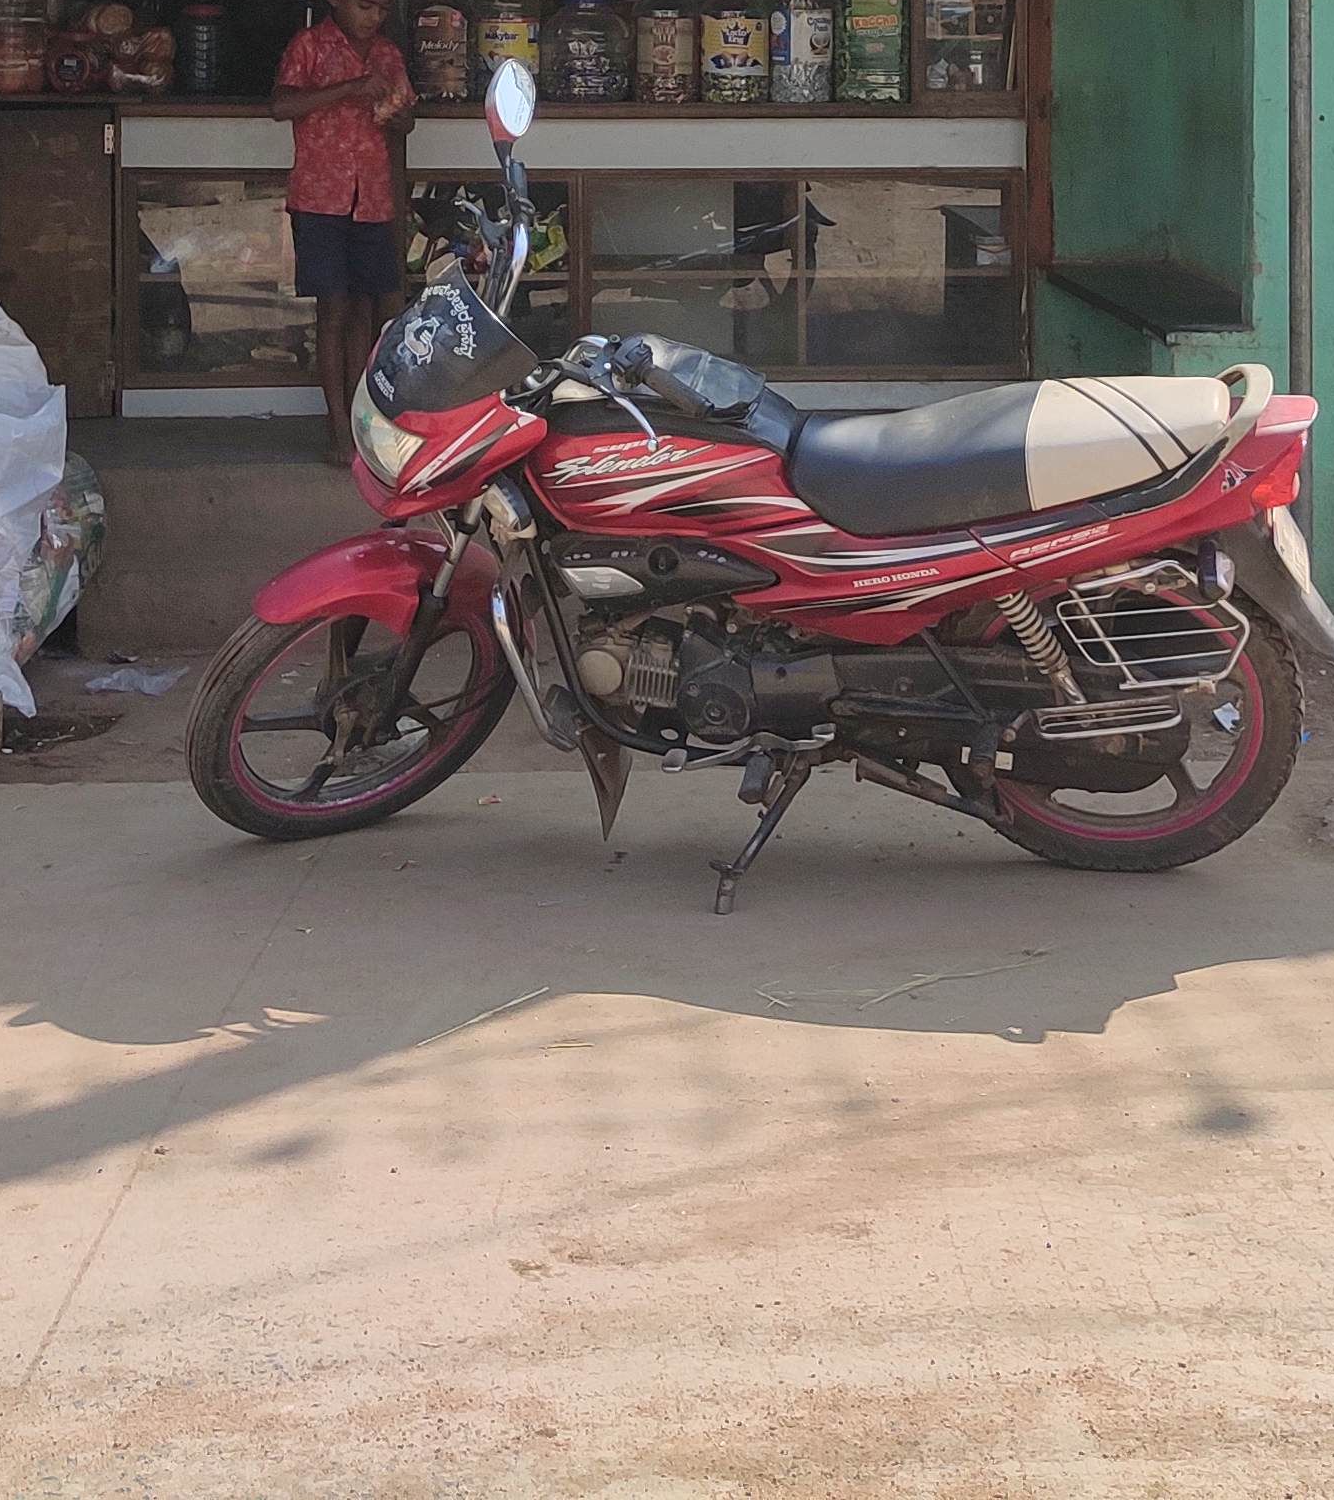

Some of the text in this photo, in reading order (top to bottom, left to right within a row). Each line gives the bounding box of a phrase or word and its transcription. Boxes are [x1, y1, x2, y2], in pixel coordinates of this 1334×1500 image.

[419, 39, 460, 53] Melody
[540, 444, 715, 485] Splendor
[853, 567, 940, 588] HERO HONDA
